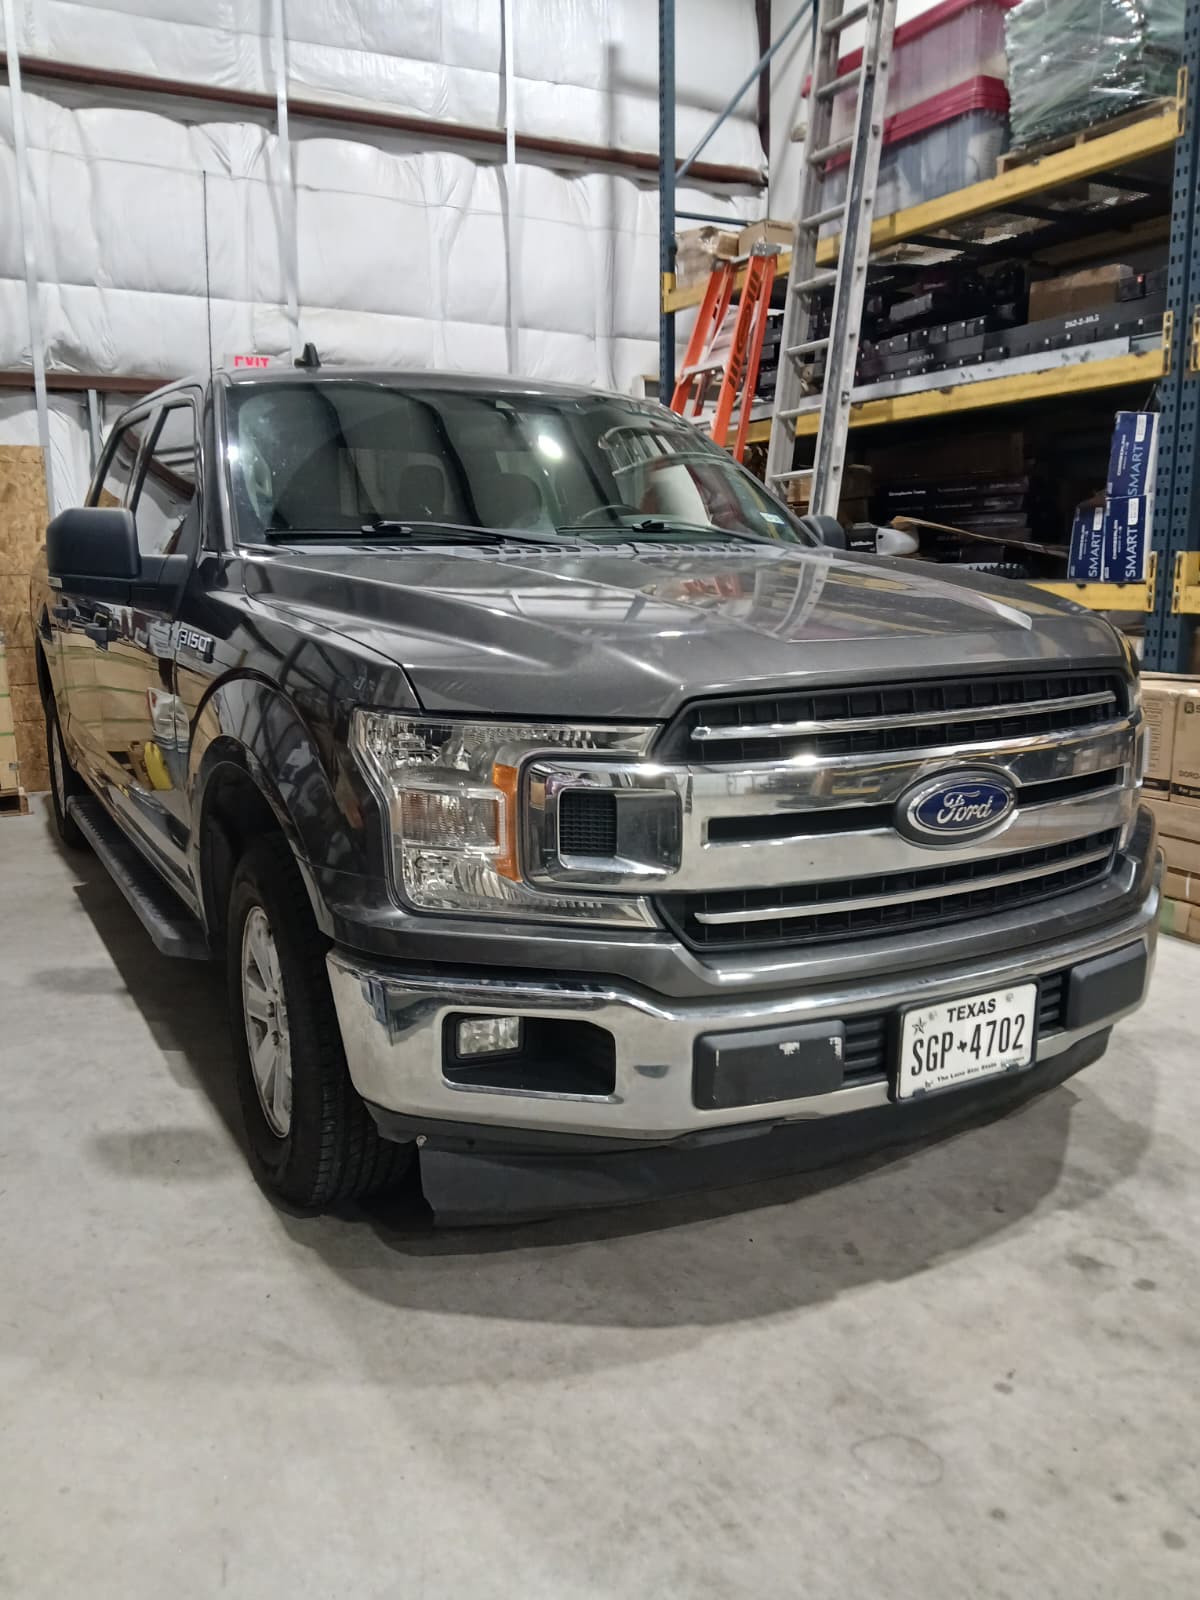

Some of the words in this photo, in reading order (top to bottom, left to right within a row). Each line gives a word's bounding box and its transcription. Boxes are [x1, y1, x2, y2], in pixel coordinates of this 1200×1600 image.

[1127, 441, 1144, 496] SMART
[1088, 531, 1102, 578] SMART
[1125, 527, 1139, 578] SMART
[937, 790, 993, 824] Ford
[947, 998, 996, 1023] TEXAS
[911, 1031, 954, 1076] SGP
[969, 1013, 1026, 1060] 4702
